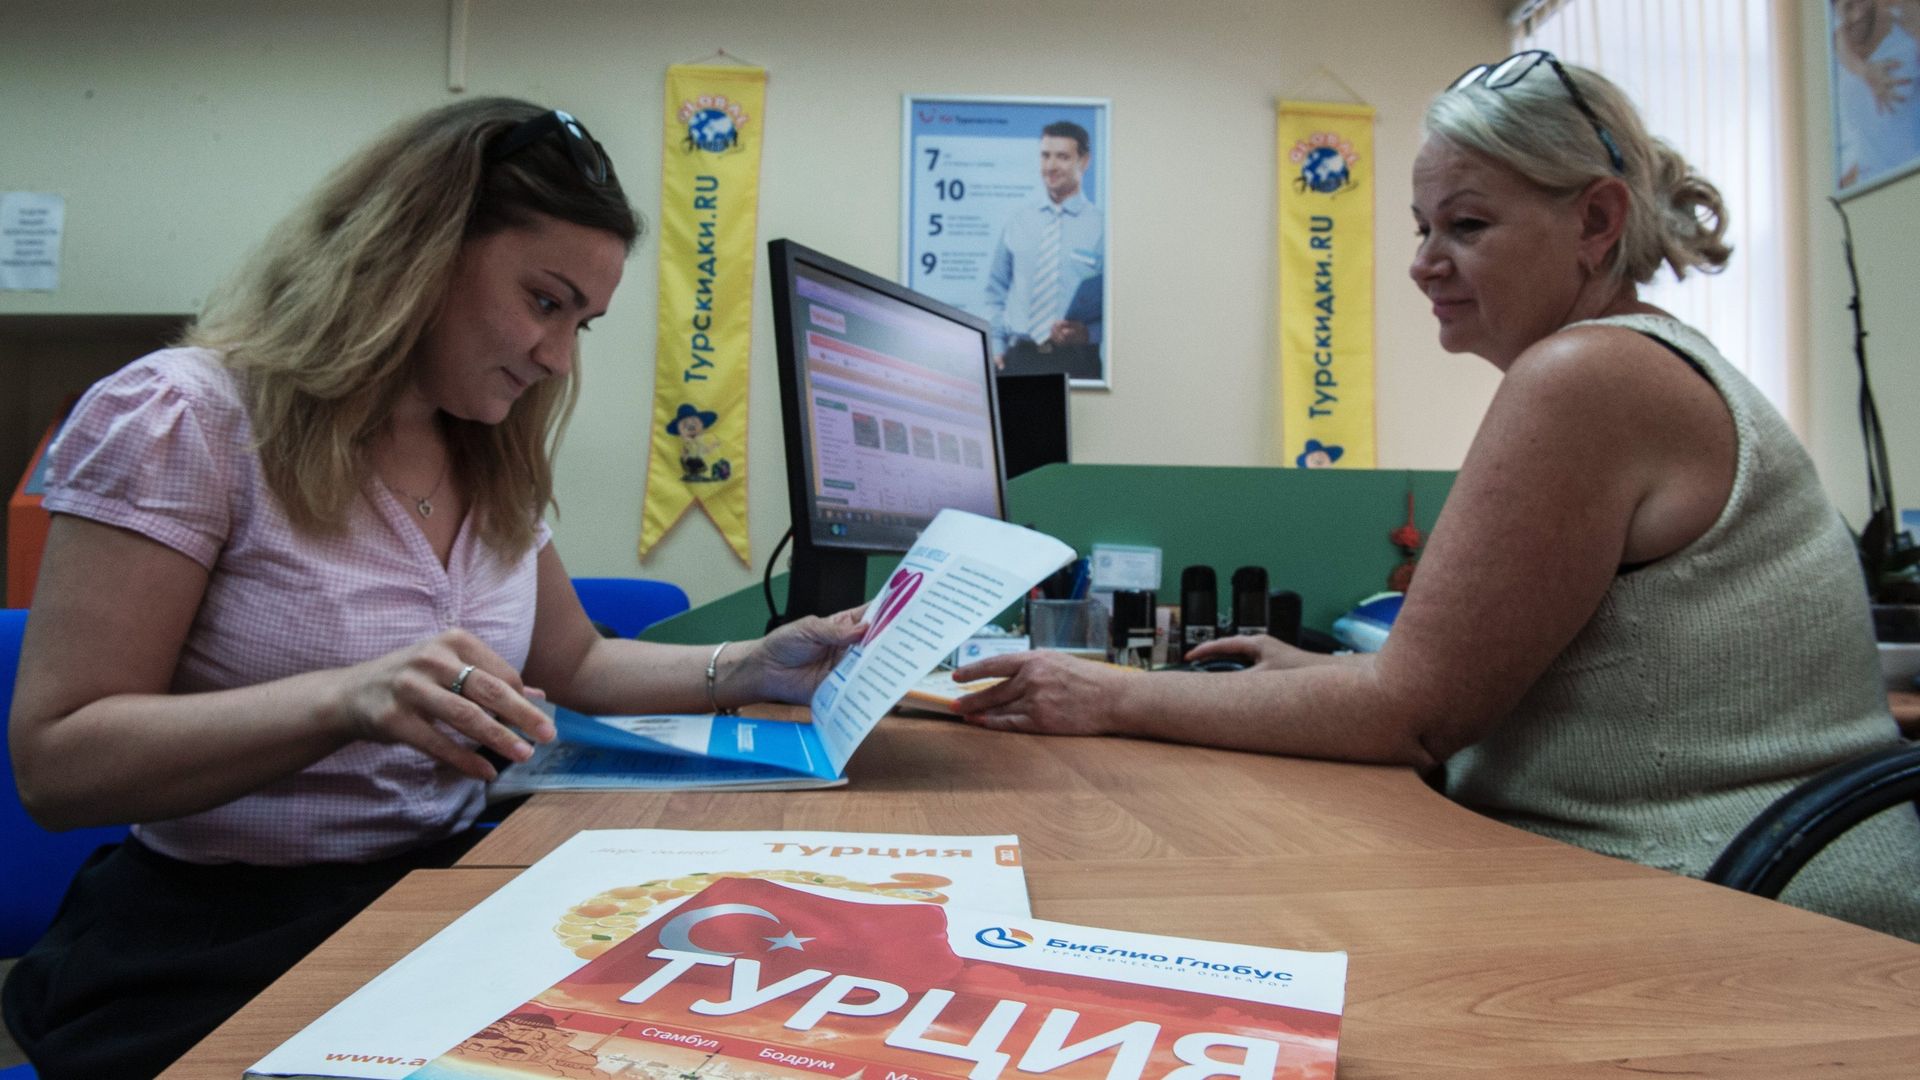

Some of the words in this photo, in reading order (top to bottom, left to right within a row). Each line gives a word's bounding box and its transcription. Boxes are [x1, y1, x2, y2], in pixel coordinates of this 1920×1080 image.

[925, 149, 940, 171] 7
[935, 179, 964, 200] 10
[929, 214, 943, 235] 5
[922, 253, 936, 275] 9
[764, 842, 973, 858] Турция
[1046, 938, 1168, 962] Библио
[1176, 956, 1293, 981] Глобус
[1198, 970, 1288, 987] ОПЕРАТОР
[619, 948, 1279, 1080] ТУРЦИЯ
[641, 1027, 720, 1049] Стамбул
[325, 1053, 427, 1067] www.a
[759, 1048, 835, 1070] Бодрум
